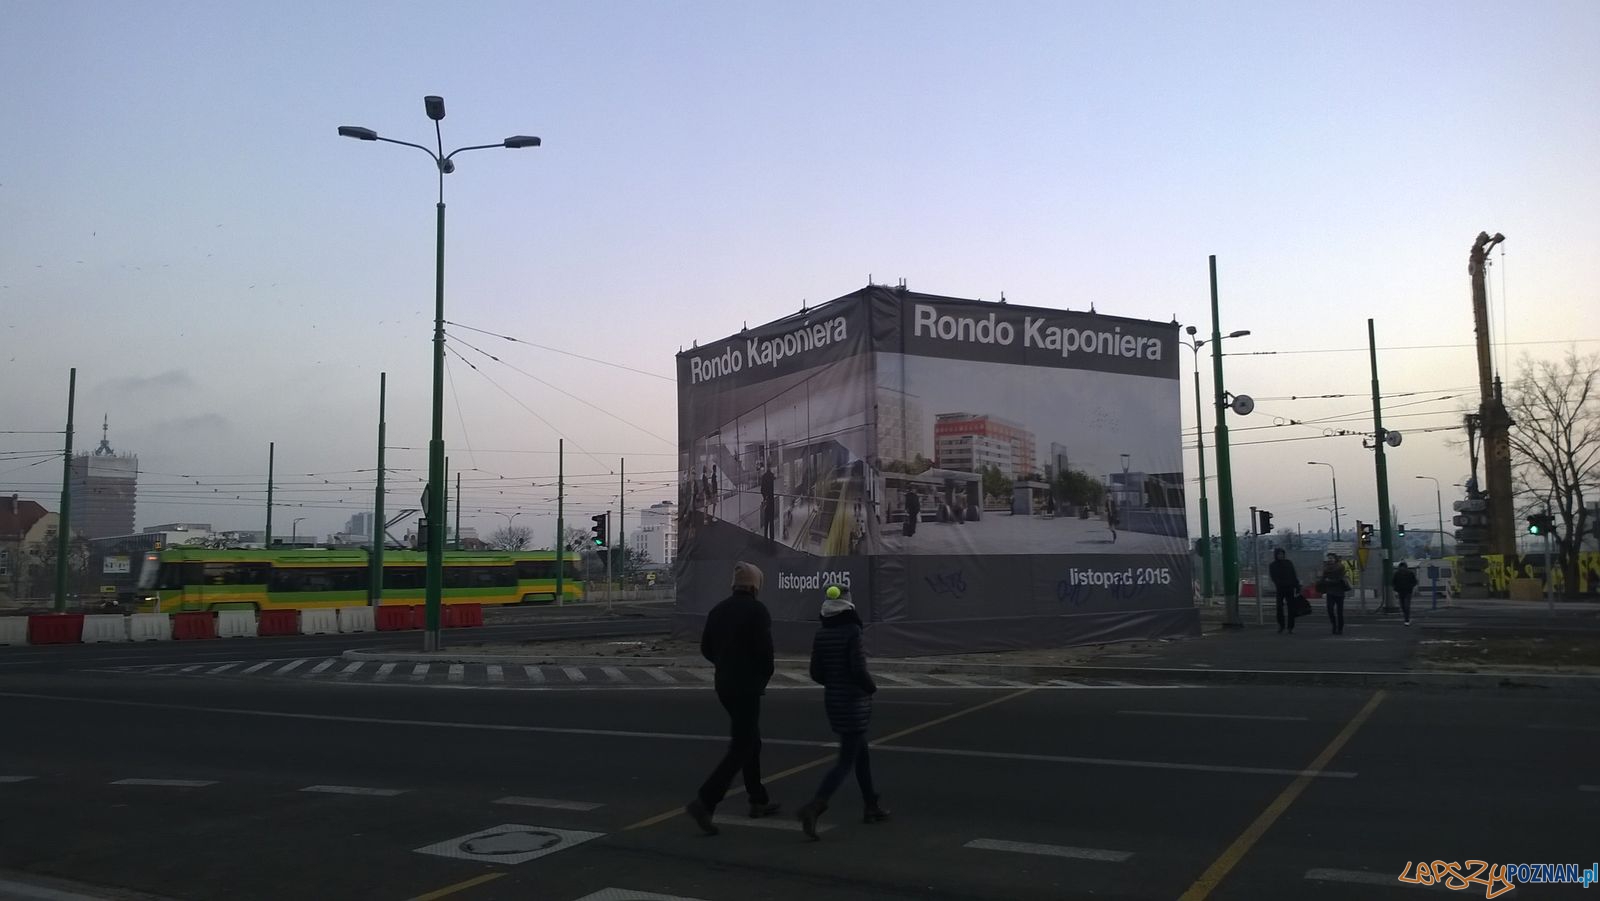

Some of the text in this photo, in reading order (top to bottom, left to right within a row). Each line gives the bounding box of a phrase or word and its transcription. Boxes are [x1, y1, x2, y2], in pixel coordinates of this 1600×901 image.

[690, 316, 848, 385] Rondo Kaponiera
[914, 304, 1162, 361] Rondo Kaponiera
[778, 570, 851, 593] listopad 2015
[1069, 567, 1133, 589] listopad
[1136, 567, 1171, 585] 2015
